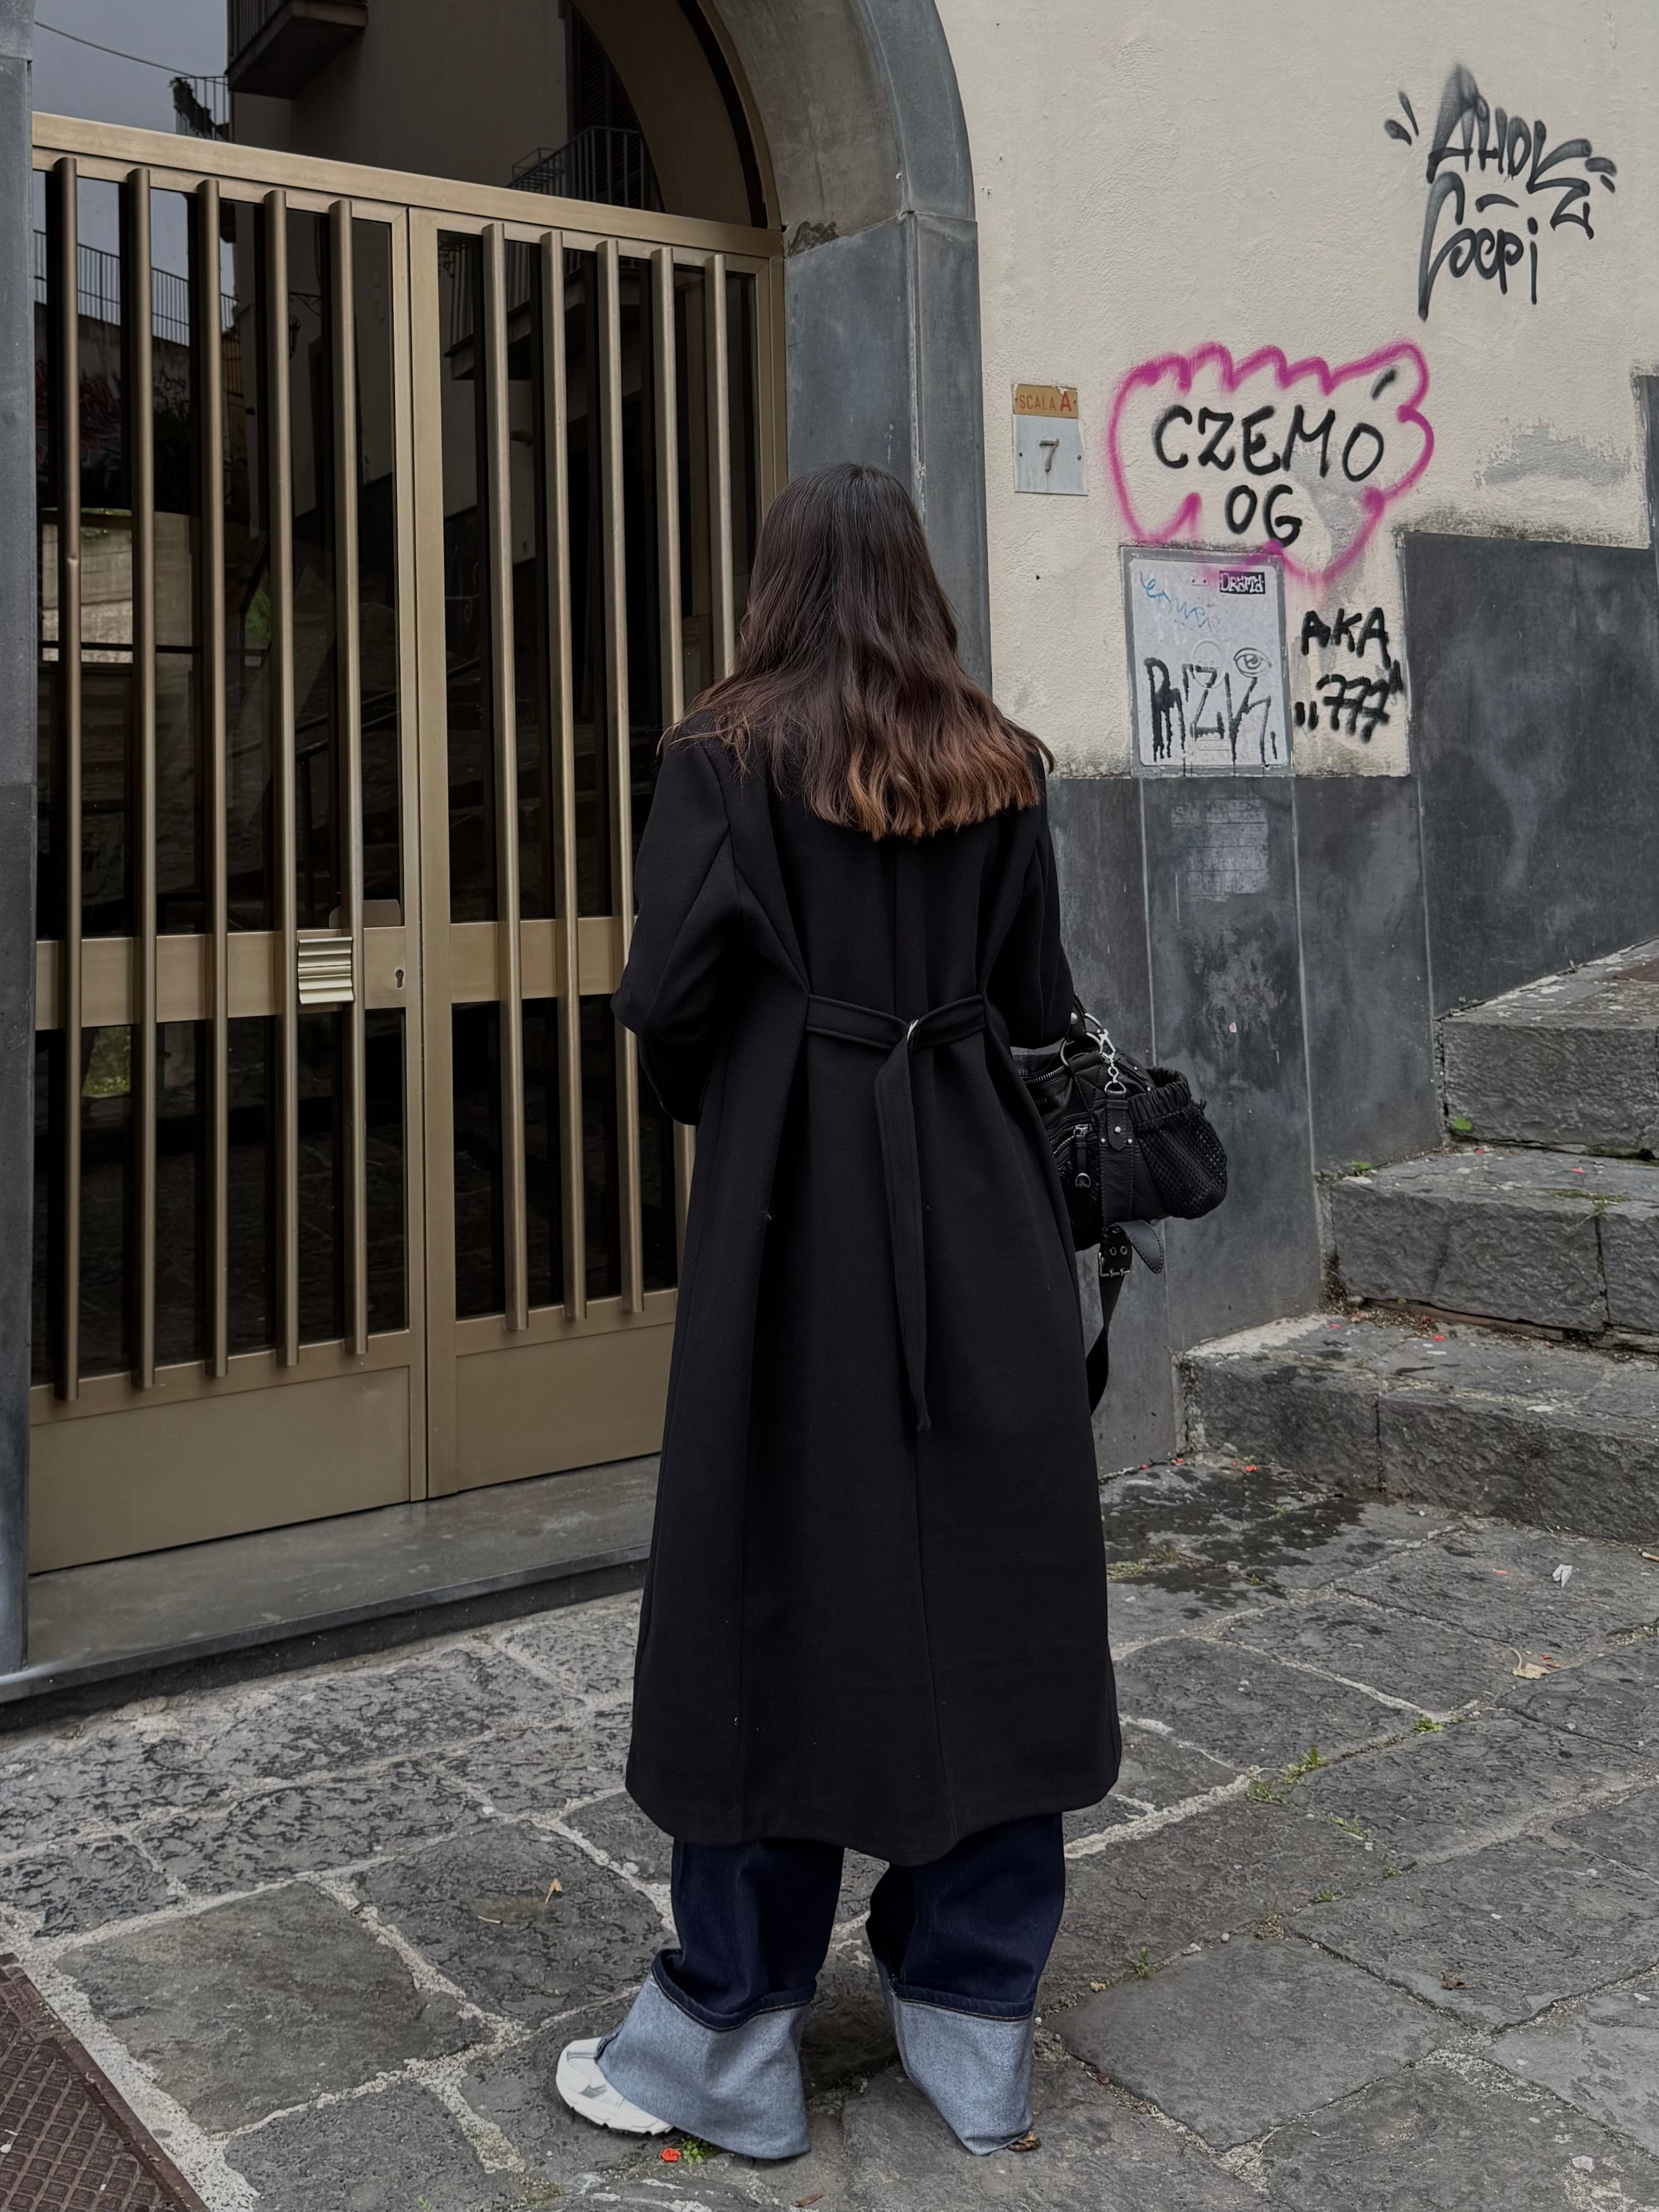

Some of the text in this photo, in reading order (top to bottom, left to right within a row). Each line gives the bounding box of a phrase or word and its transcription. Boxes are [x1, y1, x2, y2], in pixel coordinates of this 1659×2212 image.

[1019, 392, 1073, 411] SCALA A
[1039, 439, 1059, 472] 7
[1153, 404, 1385, 482] CZEMO
[1225, 485, 1302, 547] OG
[1301, 607, 1391, 669] AKA
